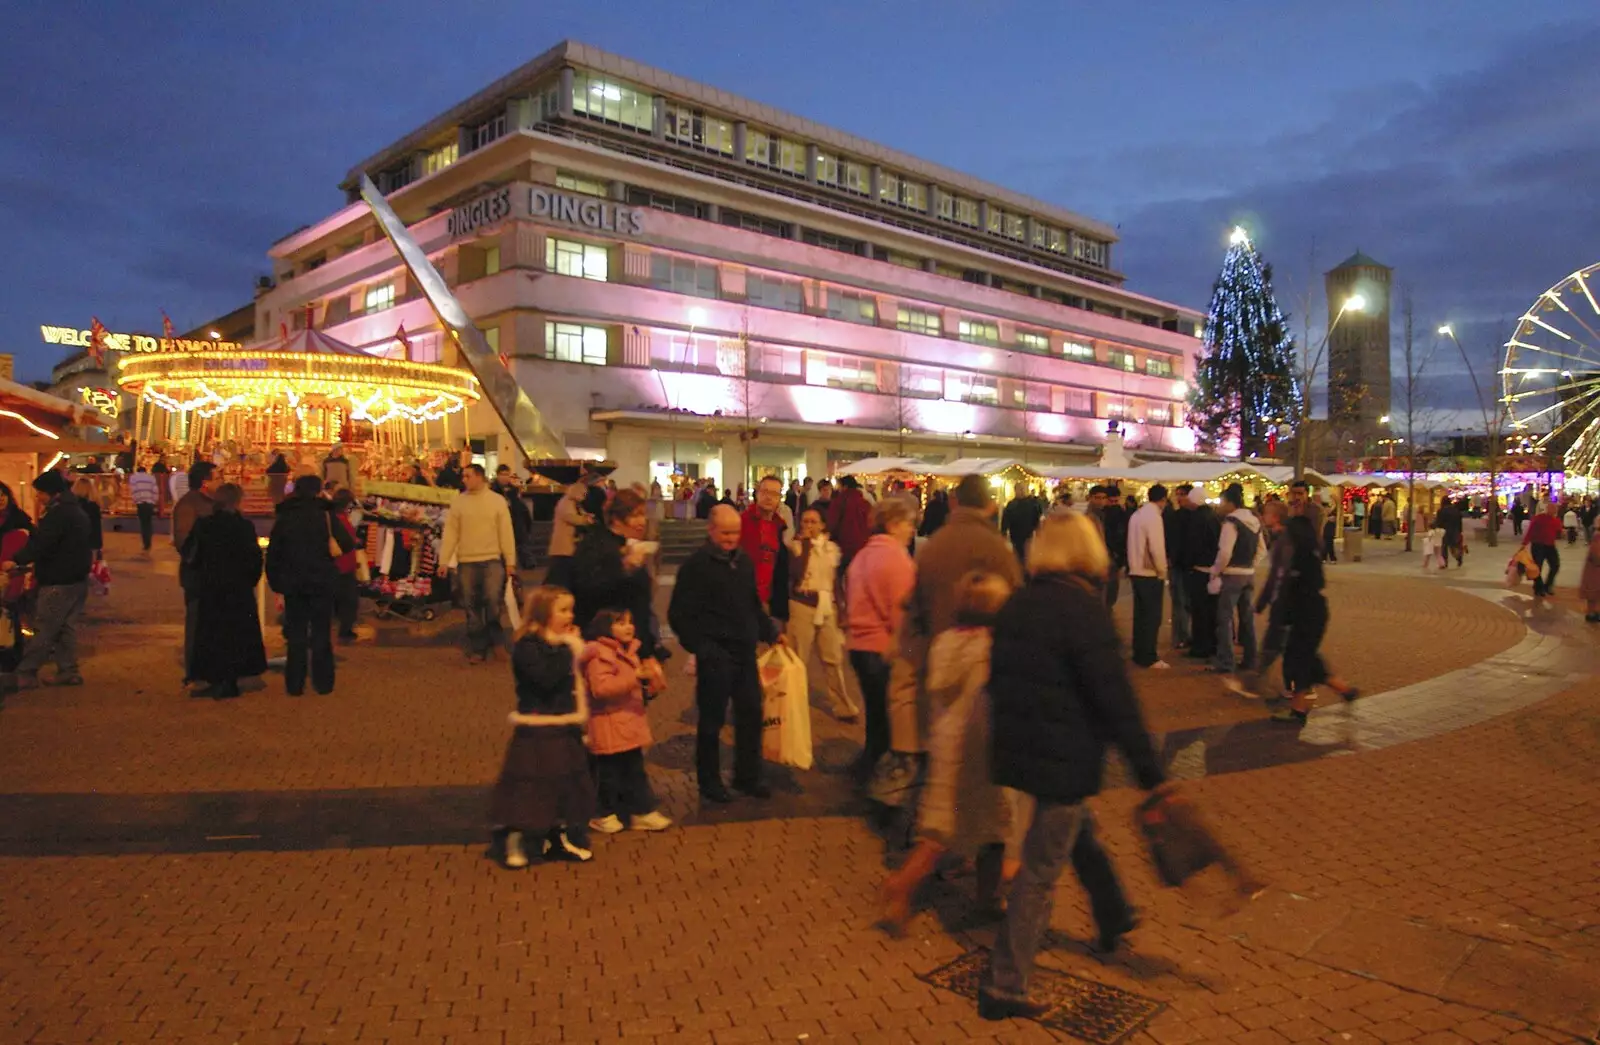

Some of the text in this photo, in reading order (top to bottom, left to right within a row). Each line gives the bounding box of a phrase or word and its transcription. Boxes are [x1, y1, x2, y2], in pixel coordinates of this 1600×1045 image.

[448, 188, 510, 235] DINGLES
[530, 188, 647, 235] DINGLES
[41, 325, 131, 351] WELCME
[132, 335, 158, 353] TO
